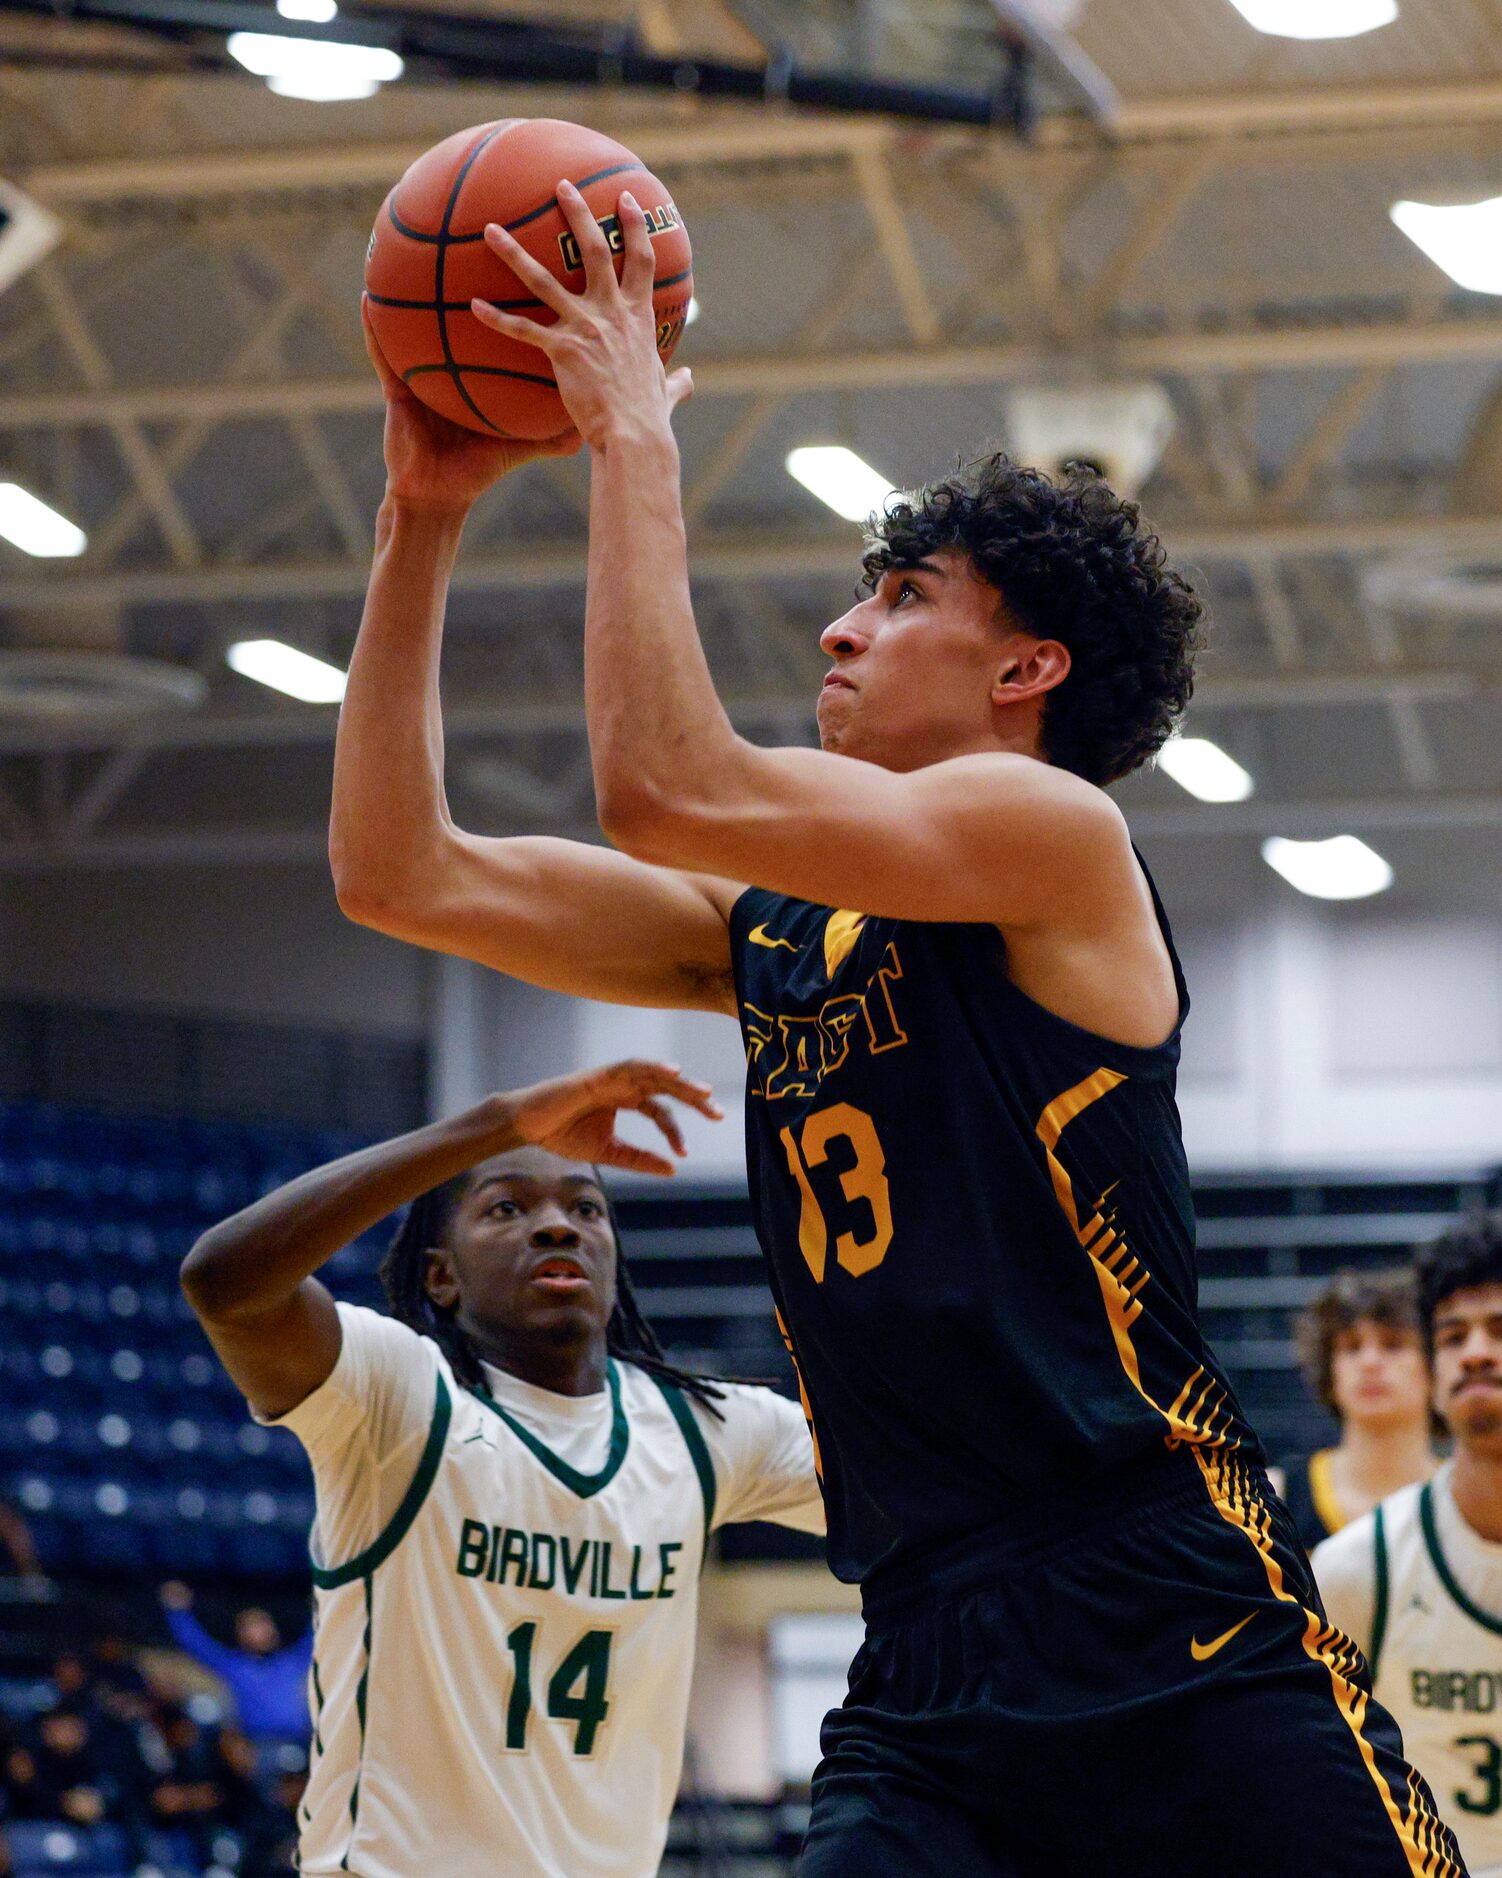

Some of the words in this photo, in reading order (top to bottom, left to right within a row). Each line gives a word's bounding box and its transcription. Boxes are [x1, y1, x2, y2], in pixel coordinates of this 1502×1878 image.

[780, 1101, 894, 1285] 13
[456, 1518, 683, 1601] BIRDVILLE
[505, 1619, 615, 1757] 14
[1411, 1669, 1502, 1714] BIRD
[1453, 1736, 1502, 1815] 3
